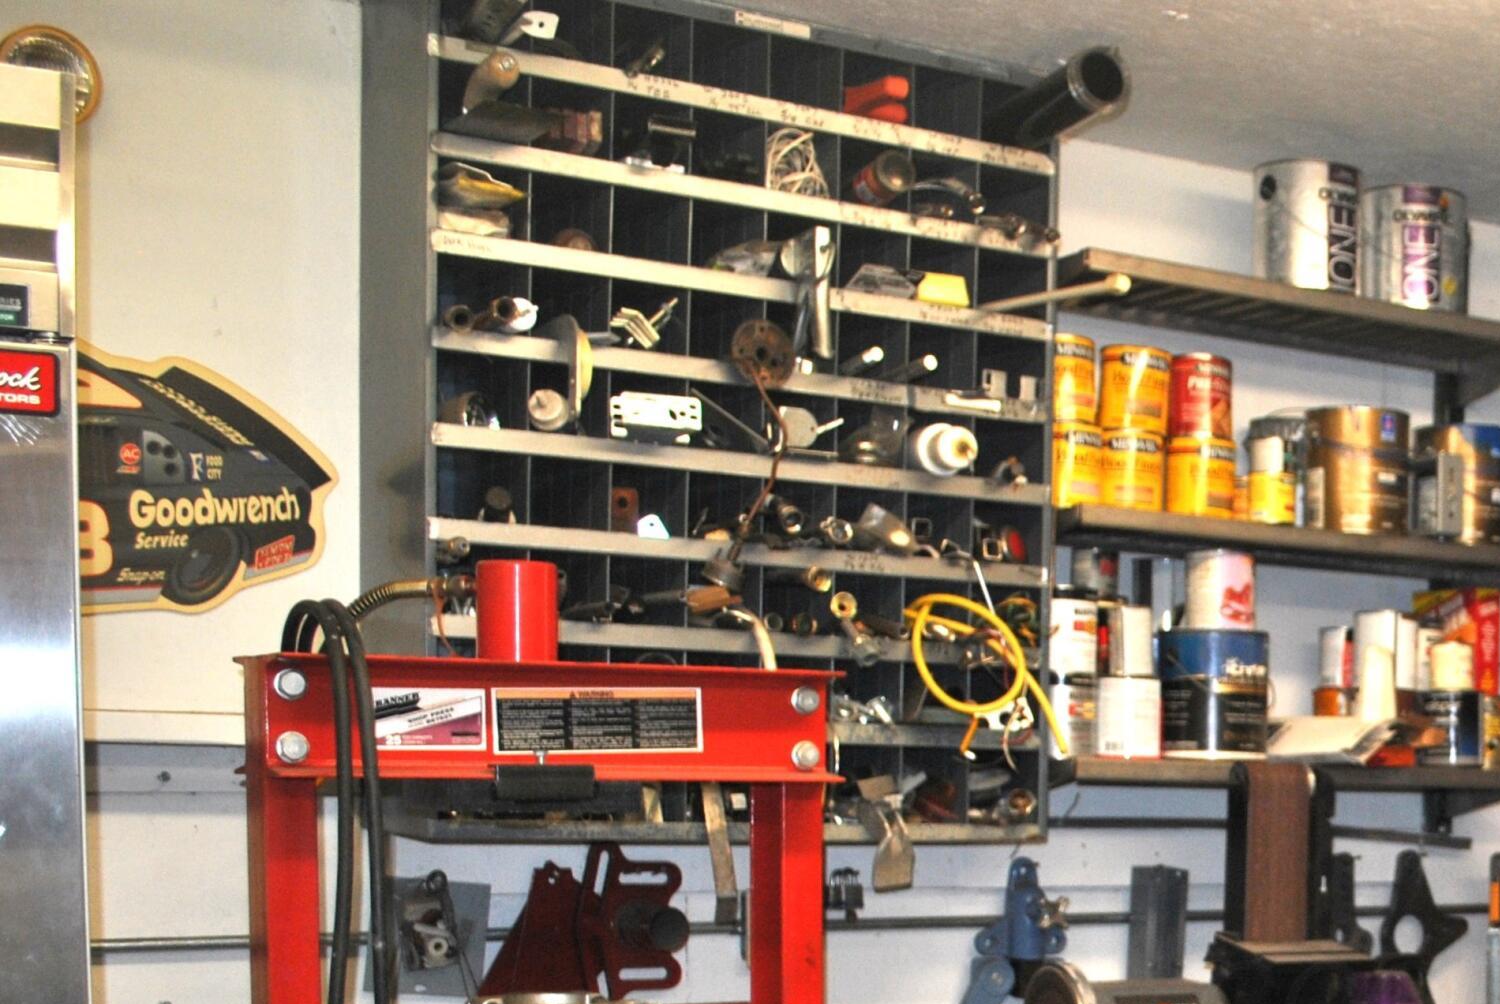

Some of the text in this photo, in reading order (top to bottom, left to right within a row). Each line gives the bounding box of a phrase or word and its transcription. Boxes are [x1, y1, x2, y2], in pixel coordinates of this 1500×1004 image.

[1404, 224, 1439, 301] ONE
[206, 468, 222, 480] CITY
[129, 486, 300, 529] Goodwrench
[134, 530, 189, 550] Service
[116, 567, 166, 584] Snap-on
